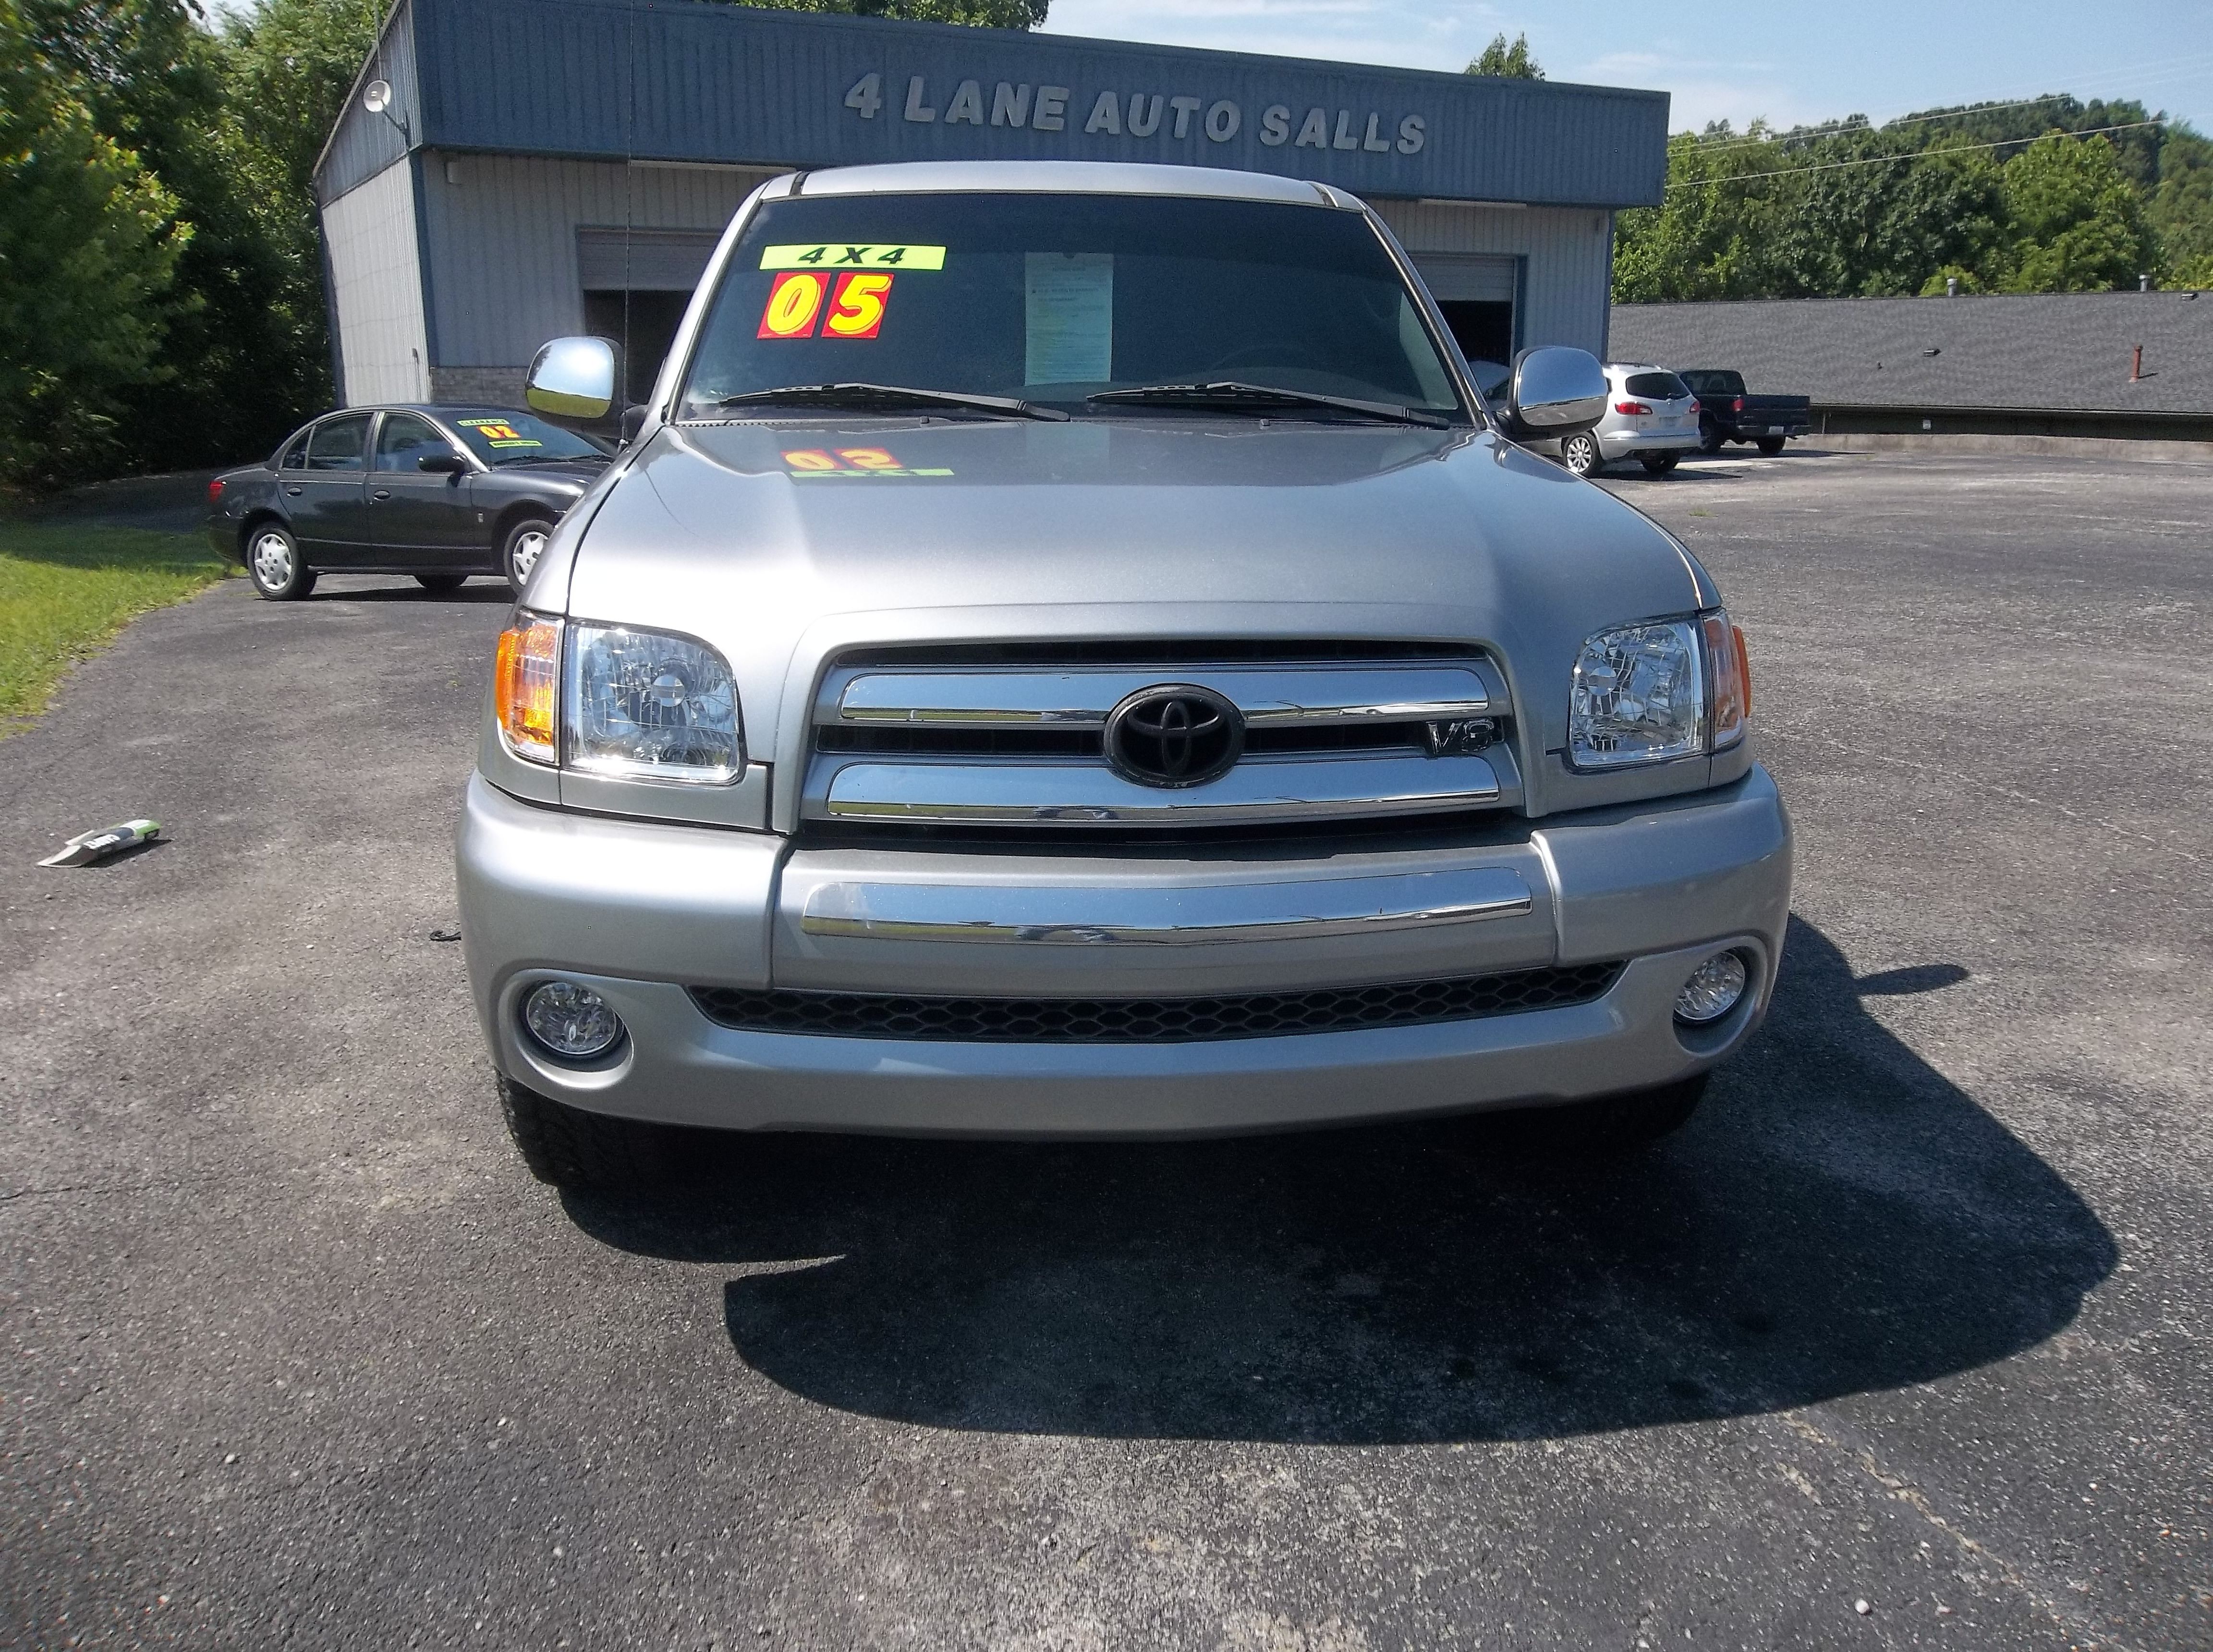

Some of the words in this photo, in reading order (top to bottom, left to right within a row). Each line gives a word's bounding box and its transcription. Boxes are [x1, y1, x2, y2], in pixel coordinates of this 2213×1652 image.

[844, 73, 882, 119] 4
[904, 75, 1070, 131] LANE
[1084, 91, 1241, 143] AUTO
[767, 274, 892, 335] 05
[480, 425, 520, 438] 02
